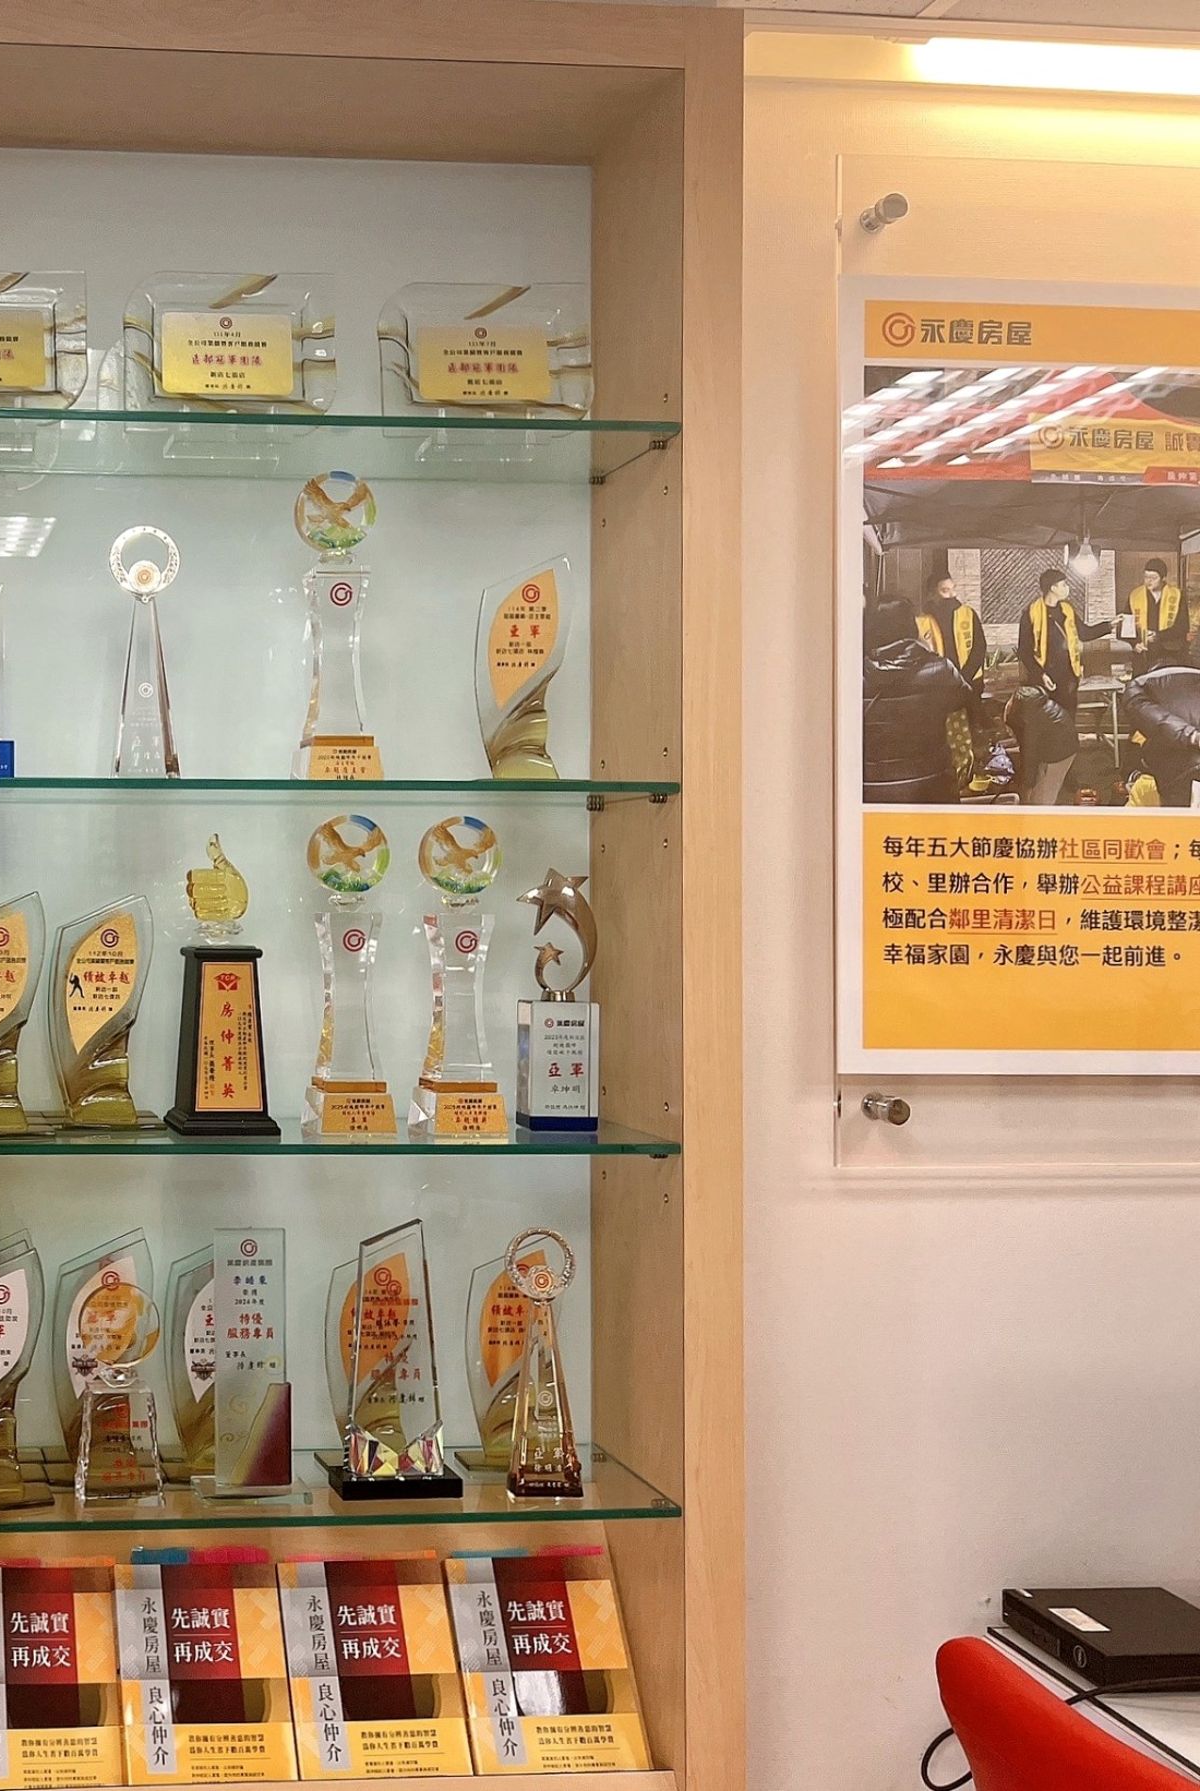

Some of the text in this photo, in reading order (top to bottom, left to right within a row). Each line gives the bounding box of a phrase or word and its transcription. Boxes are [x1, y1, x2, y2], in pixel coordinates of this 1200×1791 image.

[921, 319, 1032, 346] 永慶房屋
[1069, 425, 1154, 450] 永慶房屋
[883, 944, 1181, 968] 幸福家園，永慶與您一起前進。
[83, 971, 131, 985] 績效卓越
[221, 1001, 236, 1099] 房仲菁英
[548, 1062, 585, 1078] 亞軍
[171, 1607, 231, 1629] 先誠實
[337, 1604, 397, 1626] 先誠實
[506, 1600, 566, 1622] 先誠實
[10, 1612, 70, 1634] 先誠實
[173, 1641, 233, 1663] 再成交
[341, 1637, 402, 1659] 再成交
[512, 1633, 573, 1655] 再成交
[10, 1646, 71, 1668] 再成交
[141, 1597, 169, 1766] 永慶房屋 良心仲介
[306, 1595, 342, 1763] 永慶房屋 良心仲介
[476, 1590, 518, 1757] 永慶房屋 良心仲介
